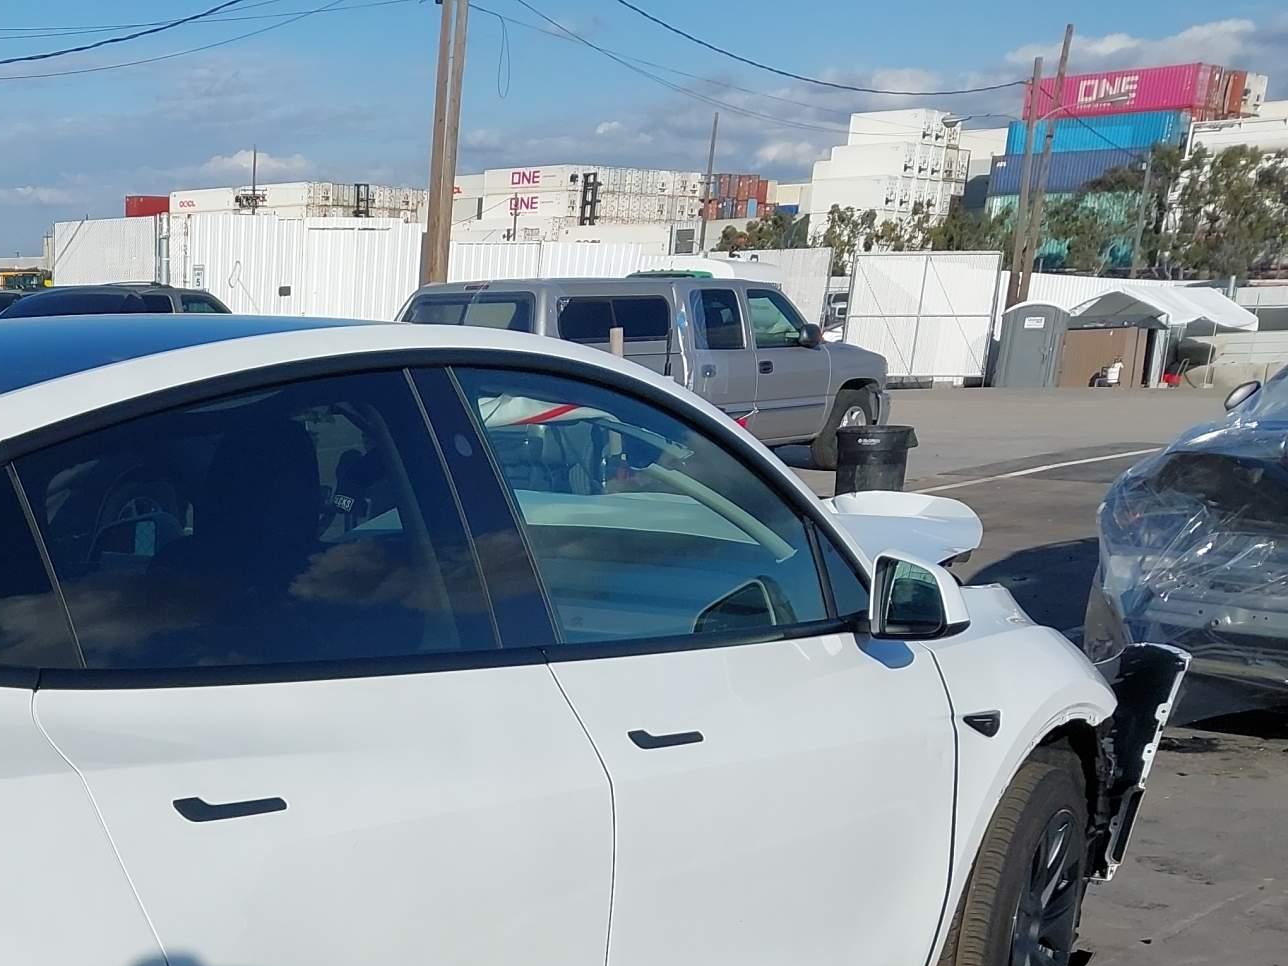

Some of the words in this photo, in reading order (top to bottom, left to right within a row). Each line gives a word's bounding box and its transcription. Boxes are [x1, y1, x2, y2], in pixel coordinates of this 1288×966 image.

[1077, 75, 1139, 104] ONE
[512, 170, 540, 185] ONE
[510, 196, 538, 210] ONE
